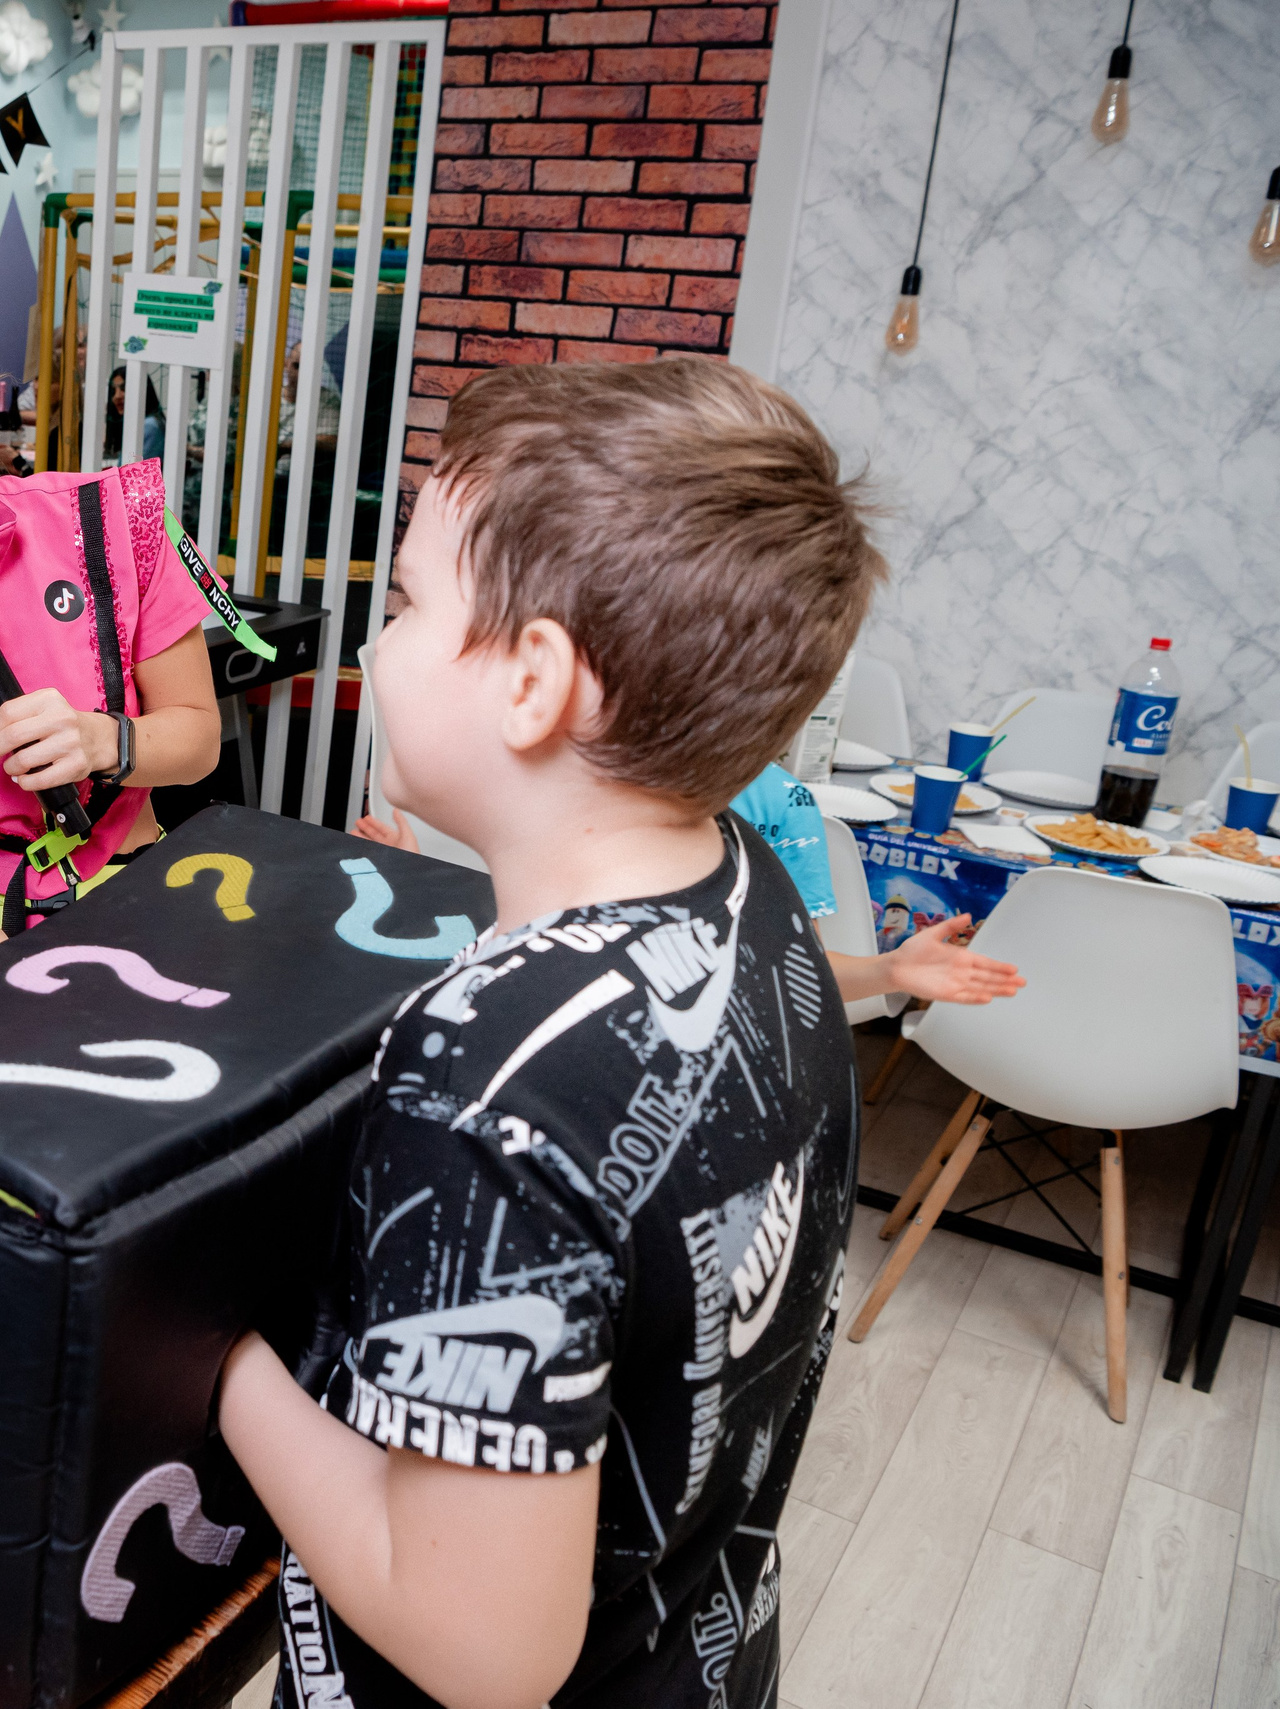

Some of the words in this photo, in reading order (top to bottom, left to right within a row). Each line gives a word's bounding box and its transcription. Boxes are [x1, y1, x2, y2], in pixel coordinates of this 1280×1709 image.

[179, 537, 204, 577] GIVE
[208, 586, 241, 628] NCHY
[626, 917, 720, 1001] NIKE
[731, 1160, 796, 1316] NIKE
[375, 1334, 533, 1414] NIKE
